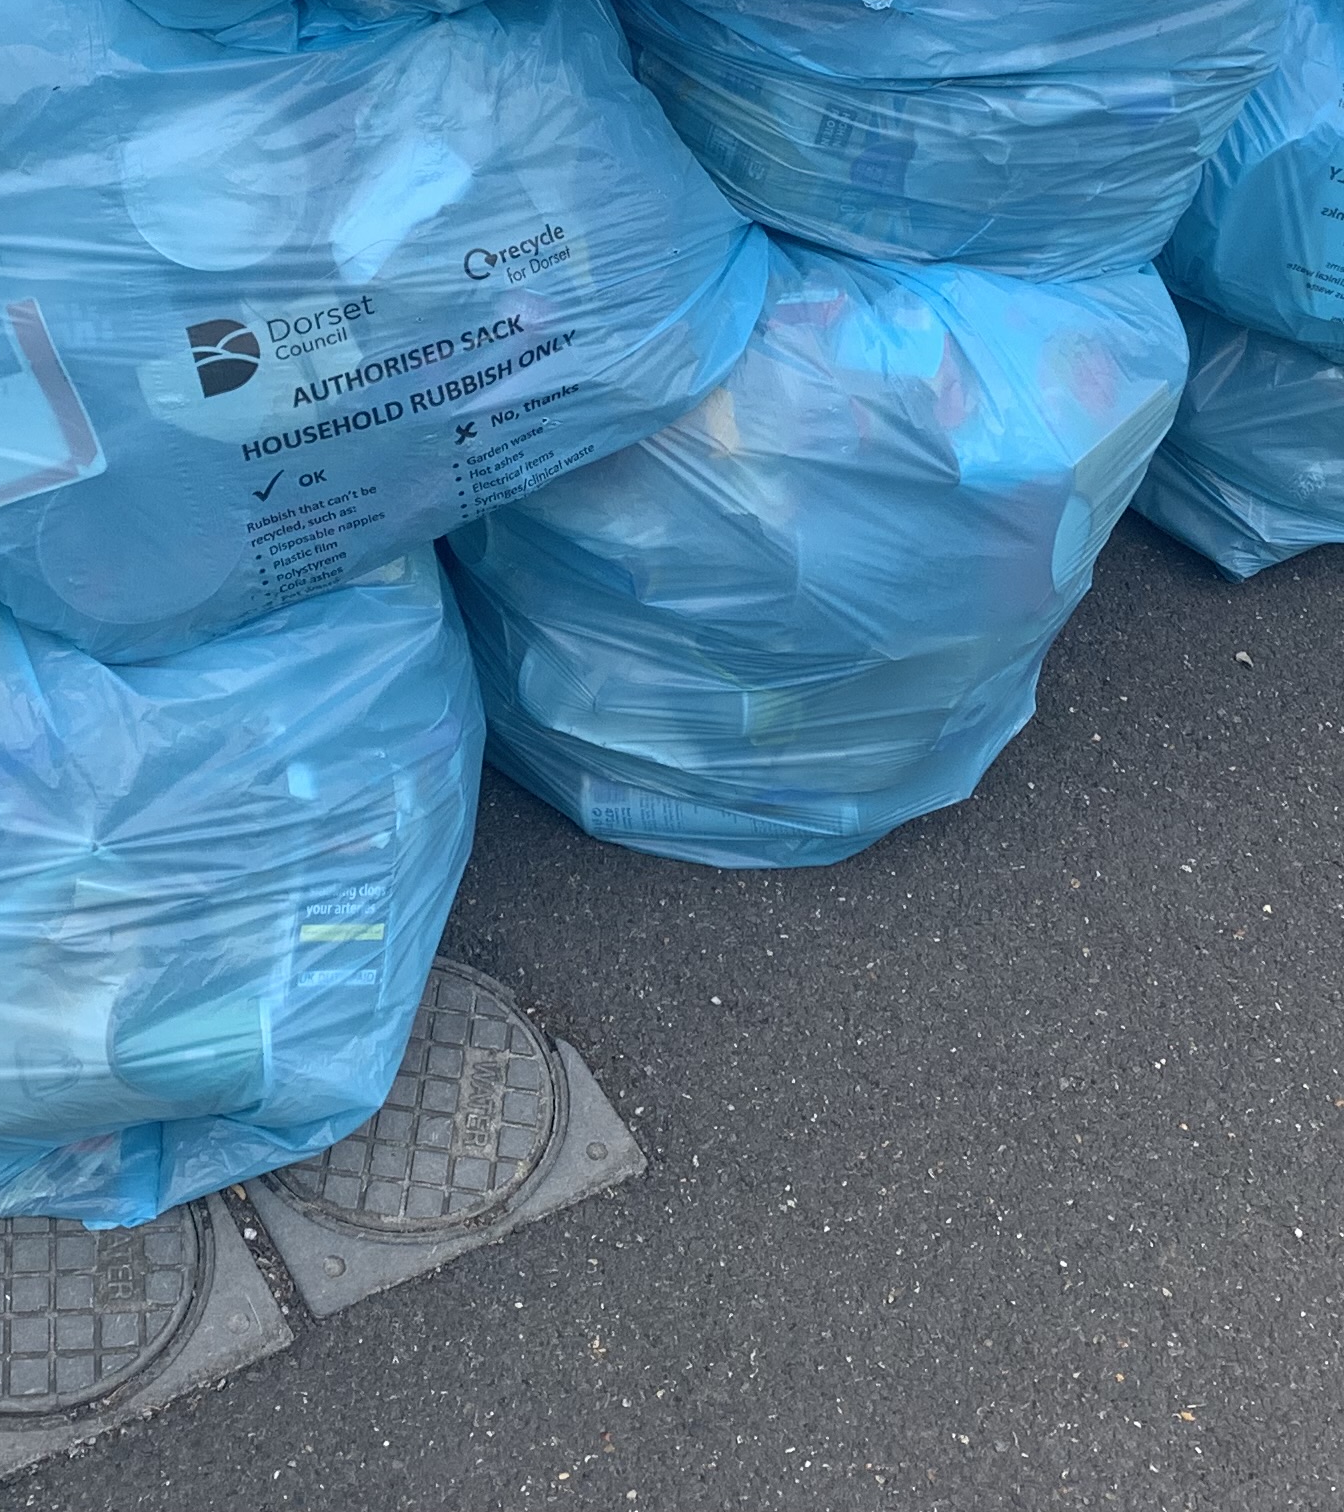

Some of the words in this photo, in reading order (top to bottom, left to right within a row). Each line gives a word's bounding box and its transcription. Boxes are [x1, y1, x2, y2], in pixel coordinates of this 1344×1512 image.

[499, 222, 565, 264] recycle
[506, 264, 528, 285] for
[530, 246, 571, 276] Dorset
[267, 294, 376, 344] Dorset
[275, 327, 349, 362] Council
[292, 339, 456, 408] AUTHORISED
[460, 313, 524, 352] SACK
[241, 399, 405, 462] HOUSEHOLD
[410, 359, 512, 415] RUBBISH
[517, 329, 576, 369] ONLY
[490, 403, 520, 429] No,
[523, 381, 580, 415] thanks
[298, 469, 328, 488] OK
